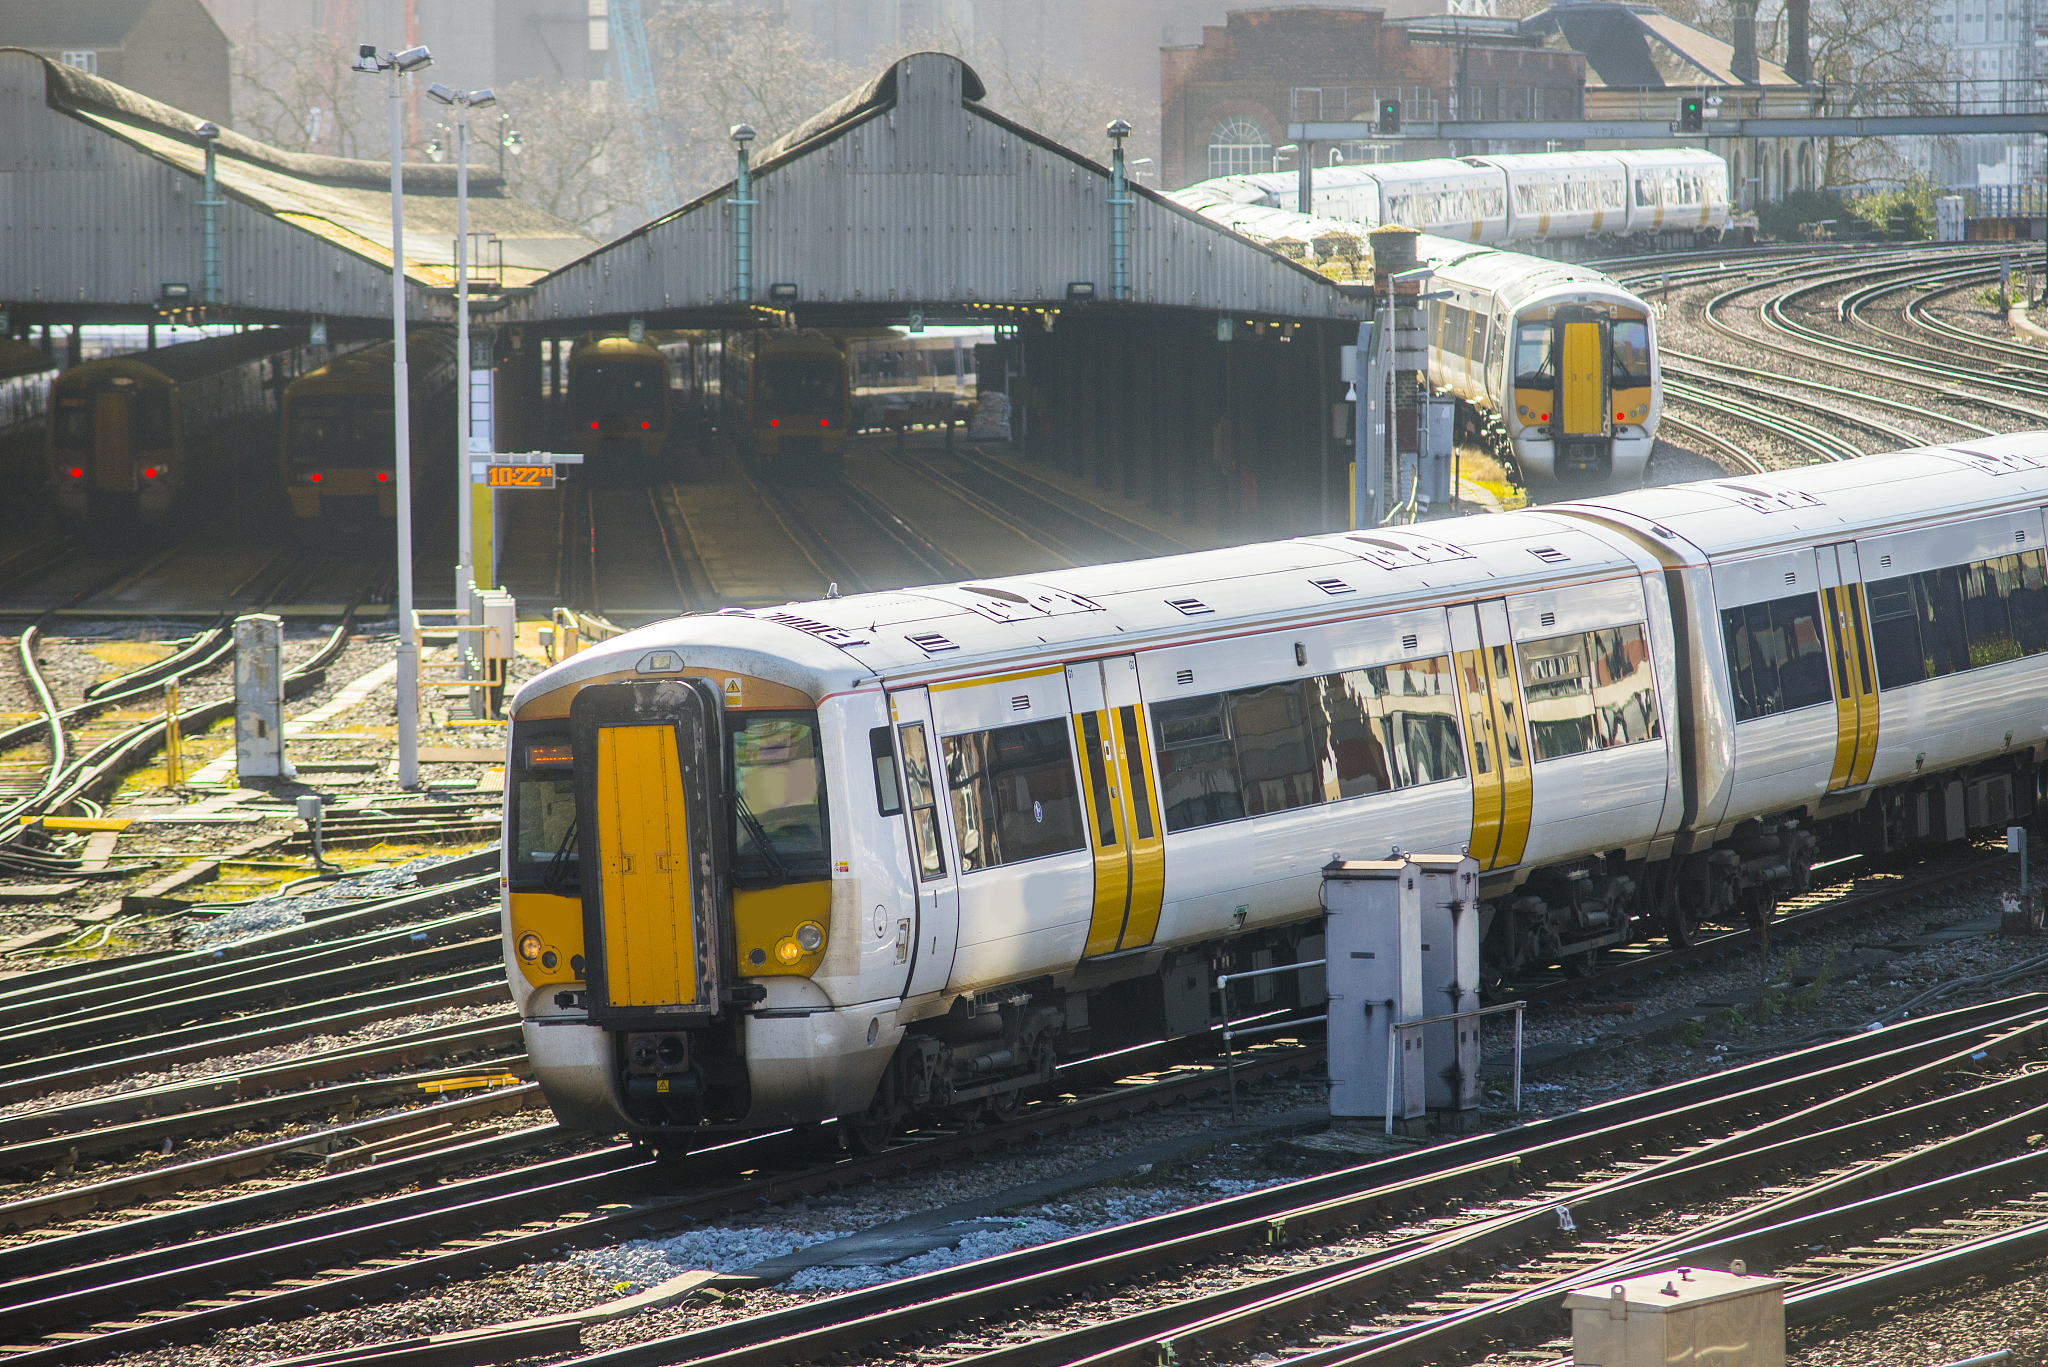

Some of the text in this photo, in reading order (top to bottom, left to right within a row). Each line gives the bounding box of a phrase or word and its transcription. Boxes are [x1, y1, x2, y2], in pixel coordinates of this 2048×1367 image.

[912, 314, 922, 329] 2
[312, 325, 326, 341] 4
[631, 323, 642, 338] 3
[1221, 322, 1228, 337] 1
[488, 467, 541, 487] 10:22
